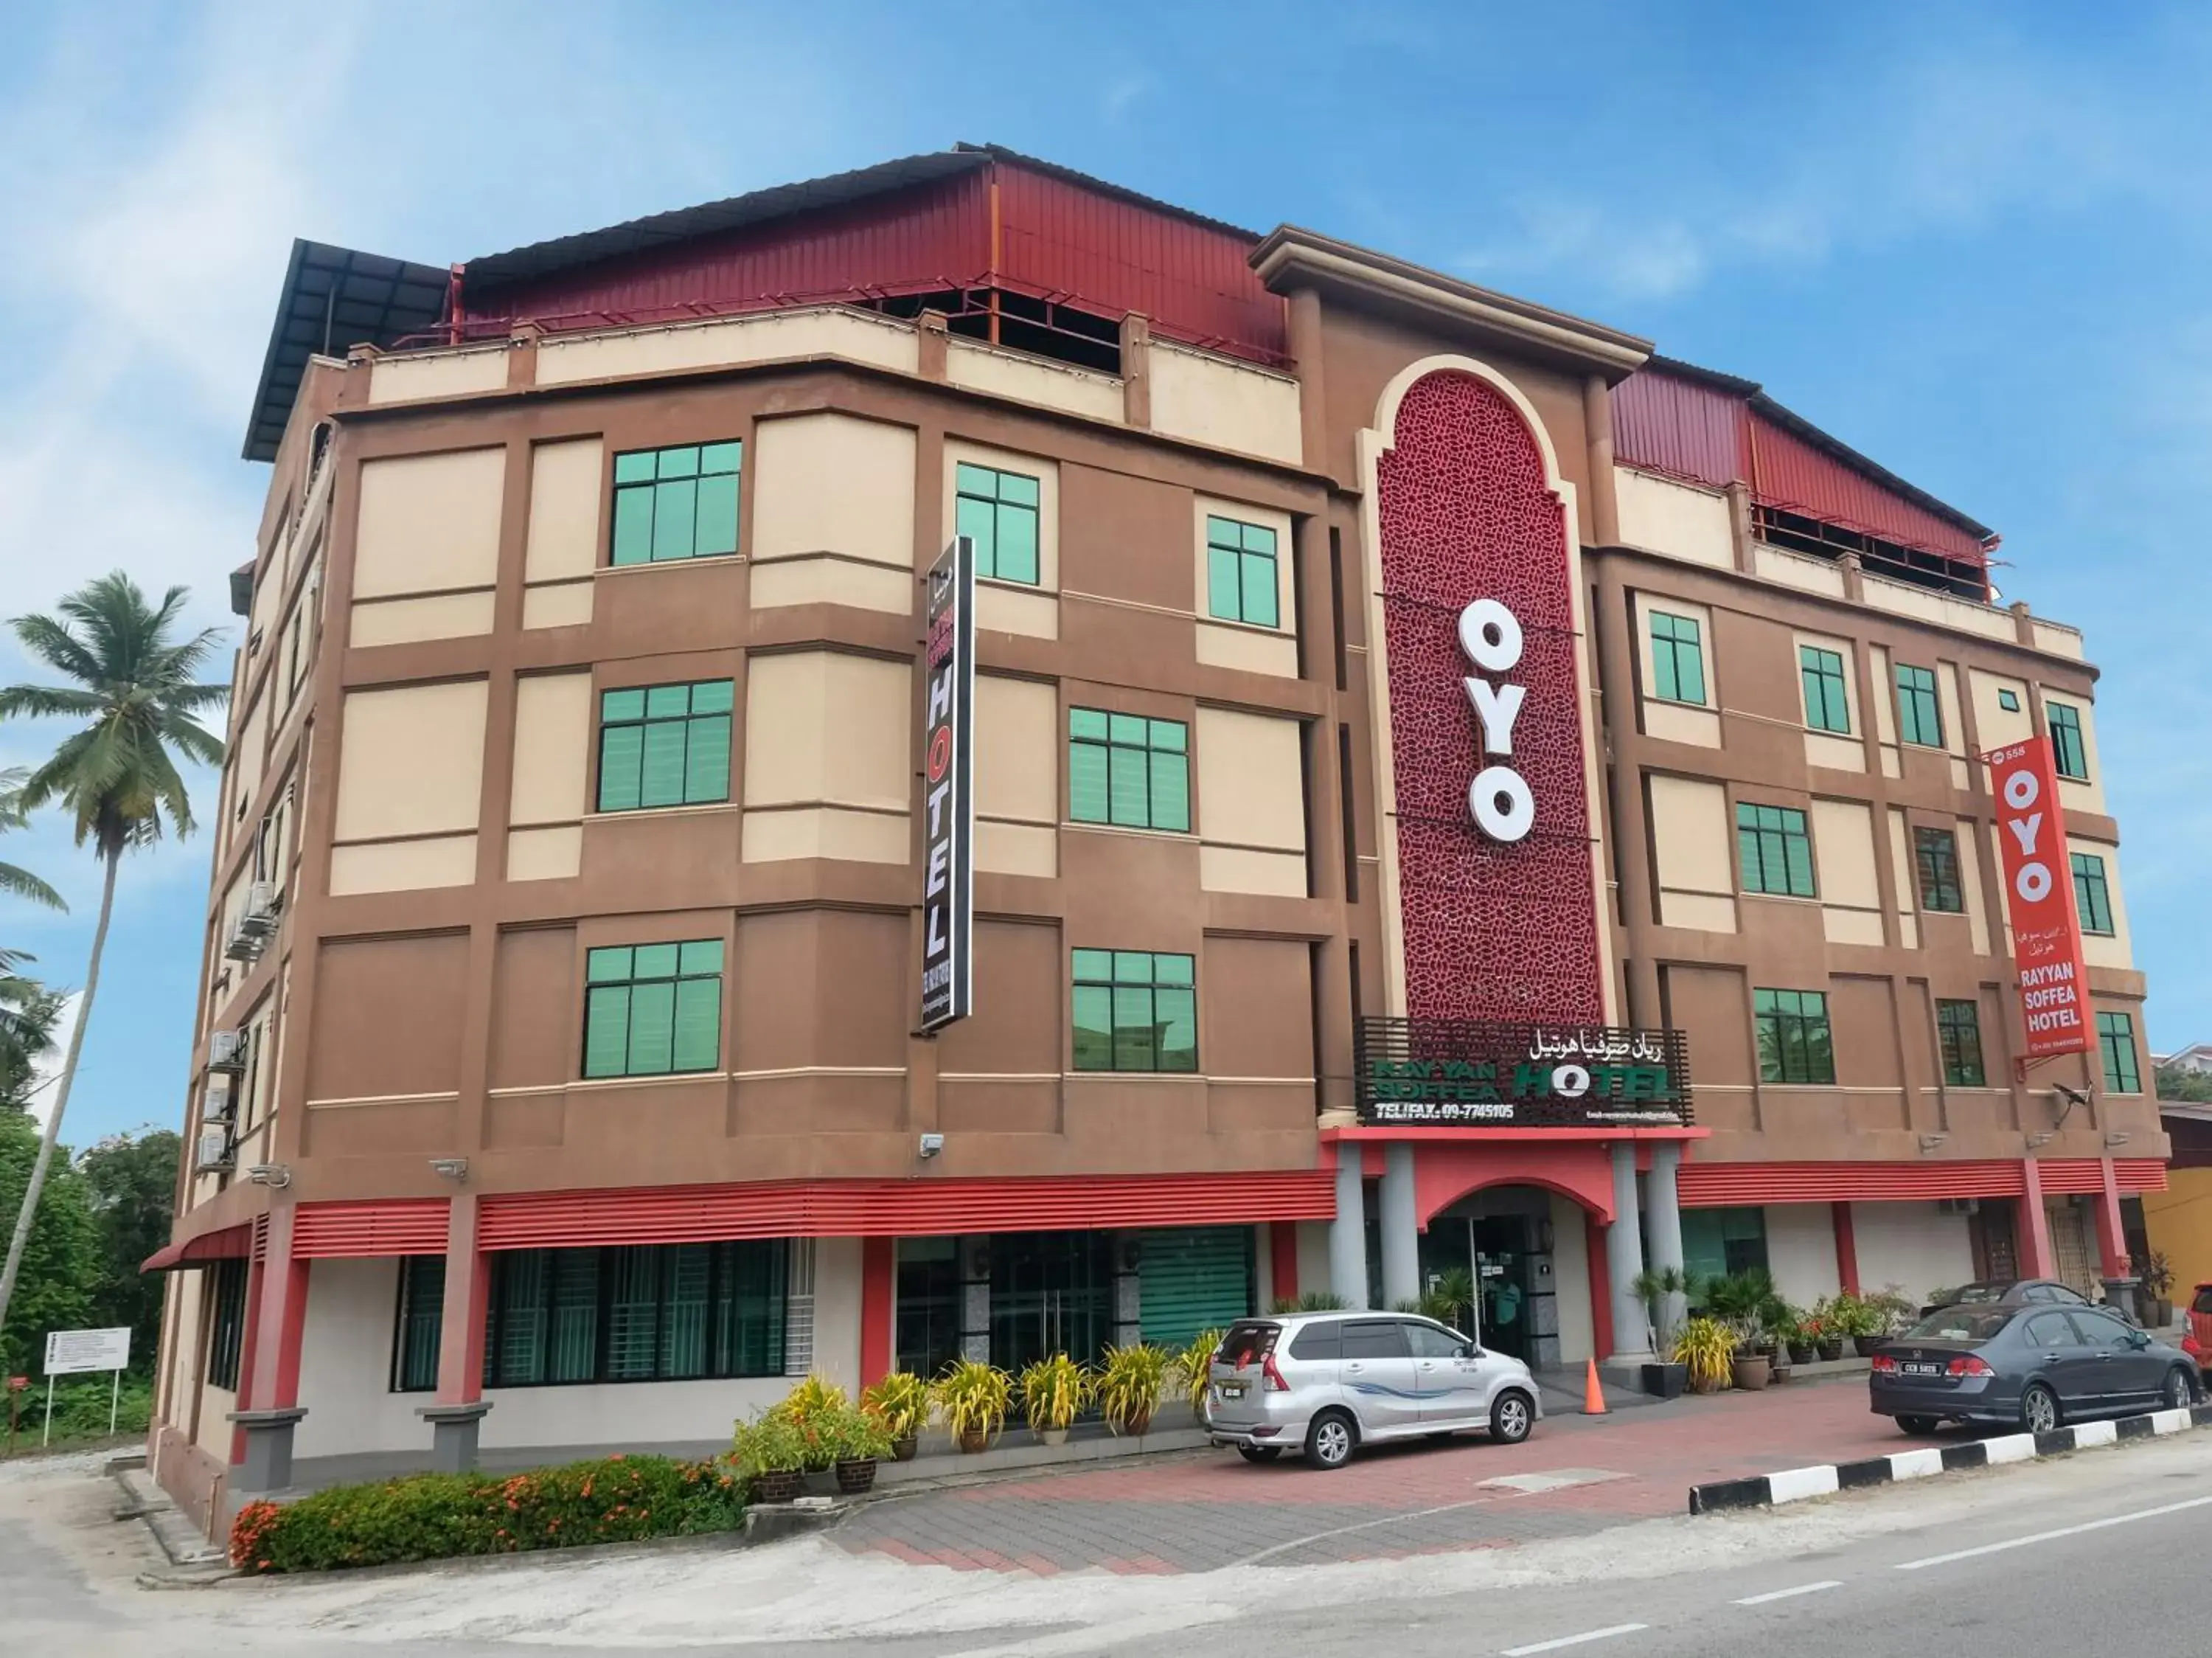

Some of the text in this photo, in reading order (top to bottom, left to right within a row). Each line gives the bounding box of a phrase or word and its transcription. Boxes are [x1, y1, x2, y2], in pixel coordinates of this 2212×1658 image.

[1458, 598, 1534, 842] OYO
[927, 665, 952, 959] HOTEL
[2004, 769, 2052, 902] OYO
[2021, 962, 2073, 988] RAYYAN
[2025, 985, 2076, 1010] SOFFEA
[2028, 1008, 2081, 1033] HOTEL
[1512, 1064, 1680, 1097] HOTEL
